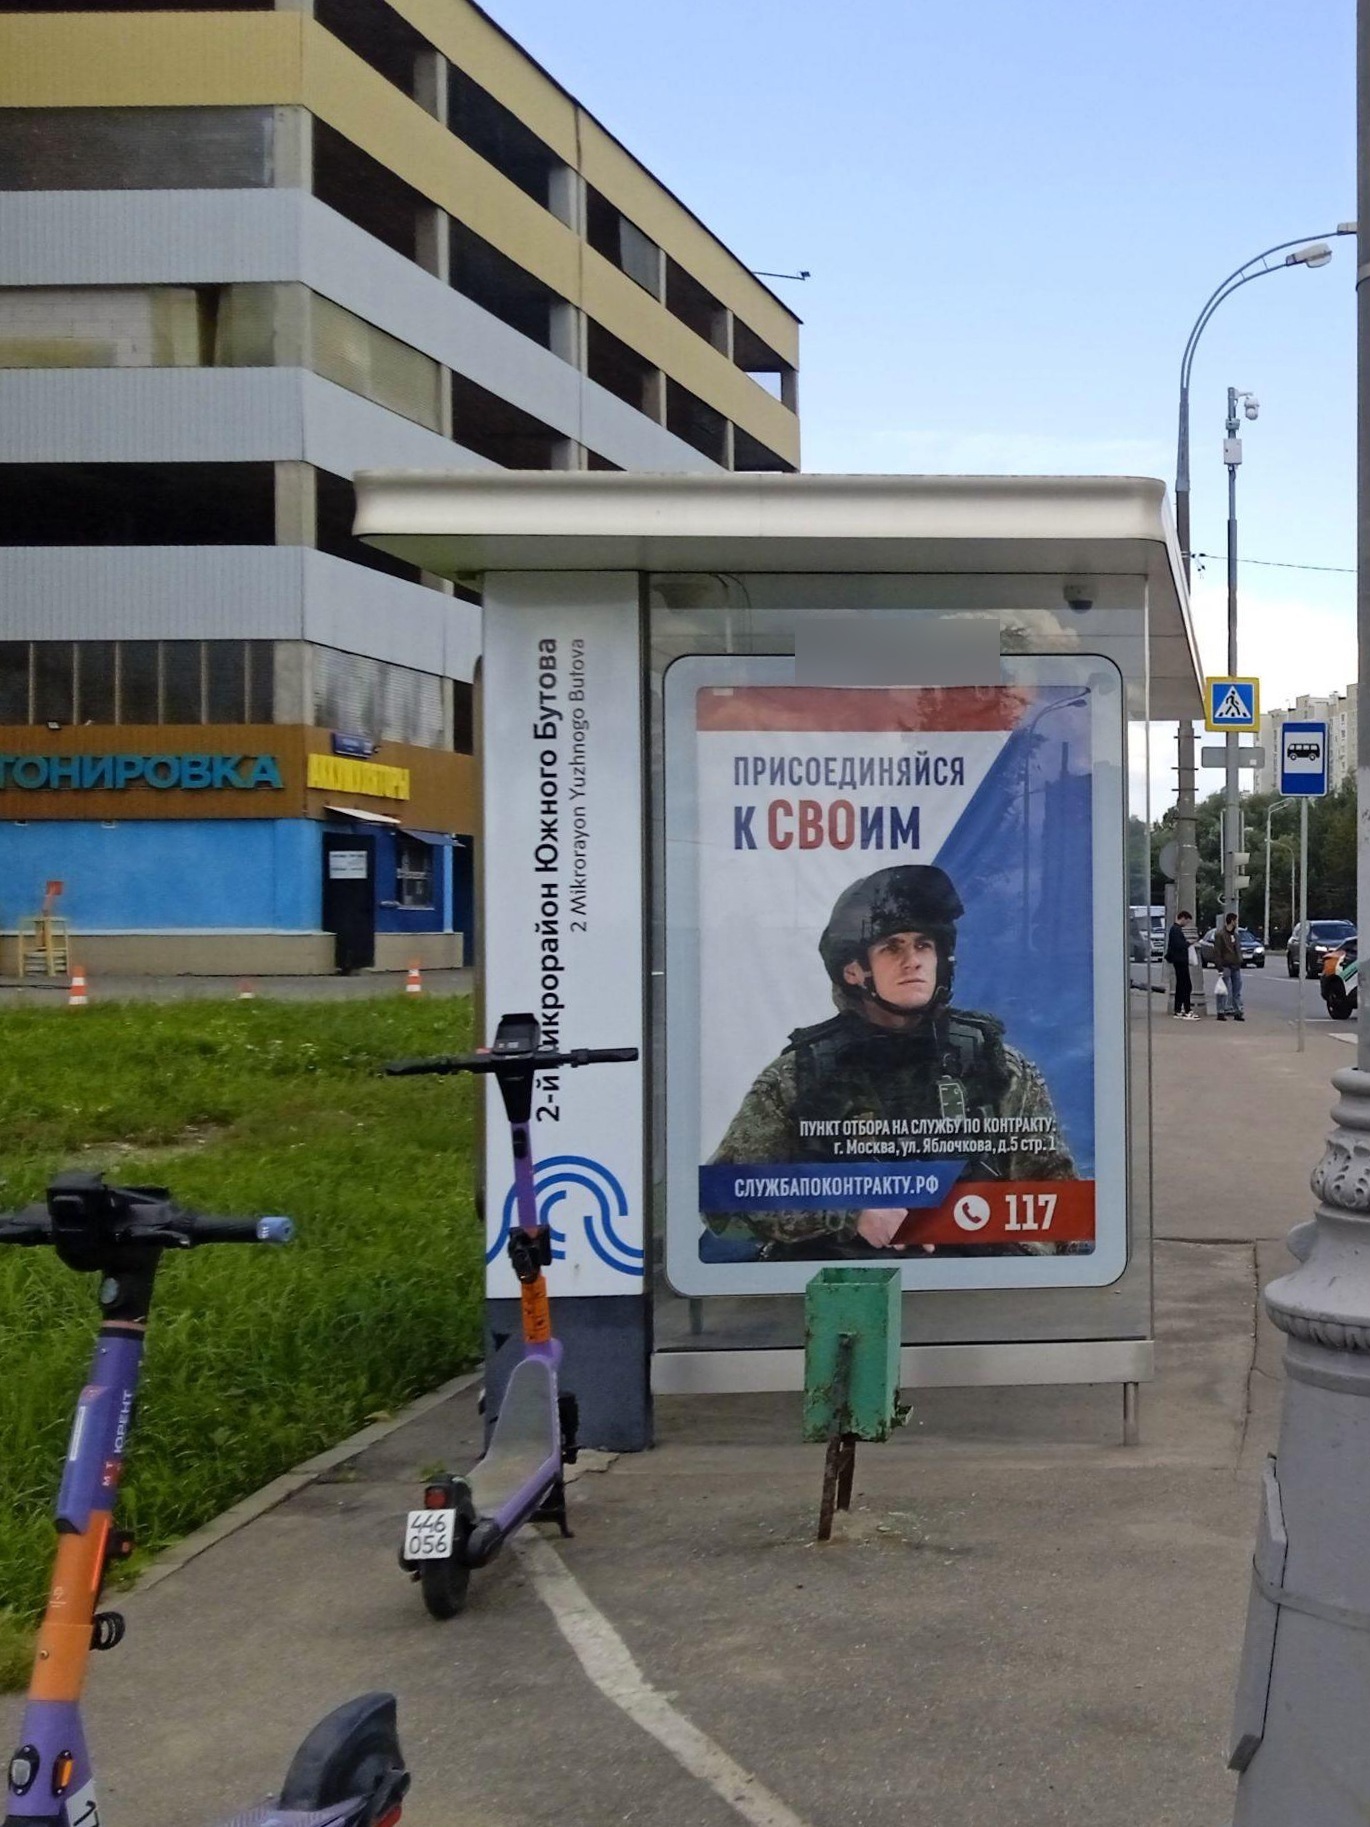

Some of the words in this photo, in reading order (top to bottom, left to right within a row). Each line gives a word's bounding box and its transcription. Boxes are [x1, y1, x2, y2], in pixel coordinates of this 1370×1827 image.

[533, 638, 563, 740] Бутова
[568, 638, 585, 701] Butova
[569, 708, 589, 800] Yuzhnogo
[734, 750, 964, 790] ПРИСОЕДИНЯЙСЯ
[534, 749, 559, 873] Южного
[734, 806, 758, 850] К
[570, 806, 590, 916] Mikrorayon
[570, 921, 587, 932] 2
[535, 883, 565, 1068] икрорайон
[536, 1075, 560, 1122] 2-й
[800, 1120, 841, 1136] ПУНКТ
[842, 1120, 890, 1135] ОТБОРА
[892, 1120, 909, 1135] НА
[911, 1118, 960, 1134] СЛУЖБУ
[963, 1118, 981, 1133] ПО
[984, 1116, 1056, 1133] КОНТРАКТУ:
[834, 1142, 844, 1154] г.
[846, 1139, 900, 1156] Москва,
[901, 1141, 921, 1157] ул.
[923, 1137, 997, 1154] Яблочкова,
[1020, 1139, 1047, 1153] стр.
[1049, 1136, 1057, 1150] 1
[734, 1175, 939, 1199] СЛУЖБАПОКОНТРАКТУ.РФ
[1004, 1194, 1058, 1232] 117
[113, 1390, 134, 1454] ЮРЕНТ
[409, 1534, 447, 1554] 056
[410, 1513, 447, 1533] 446
